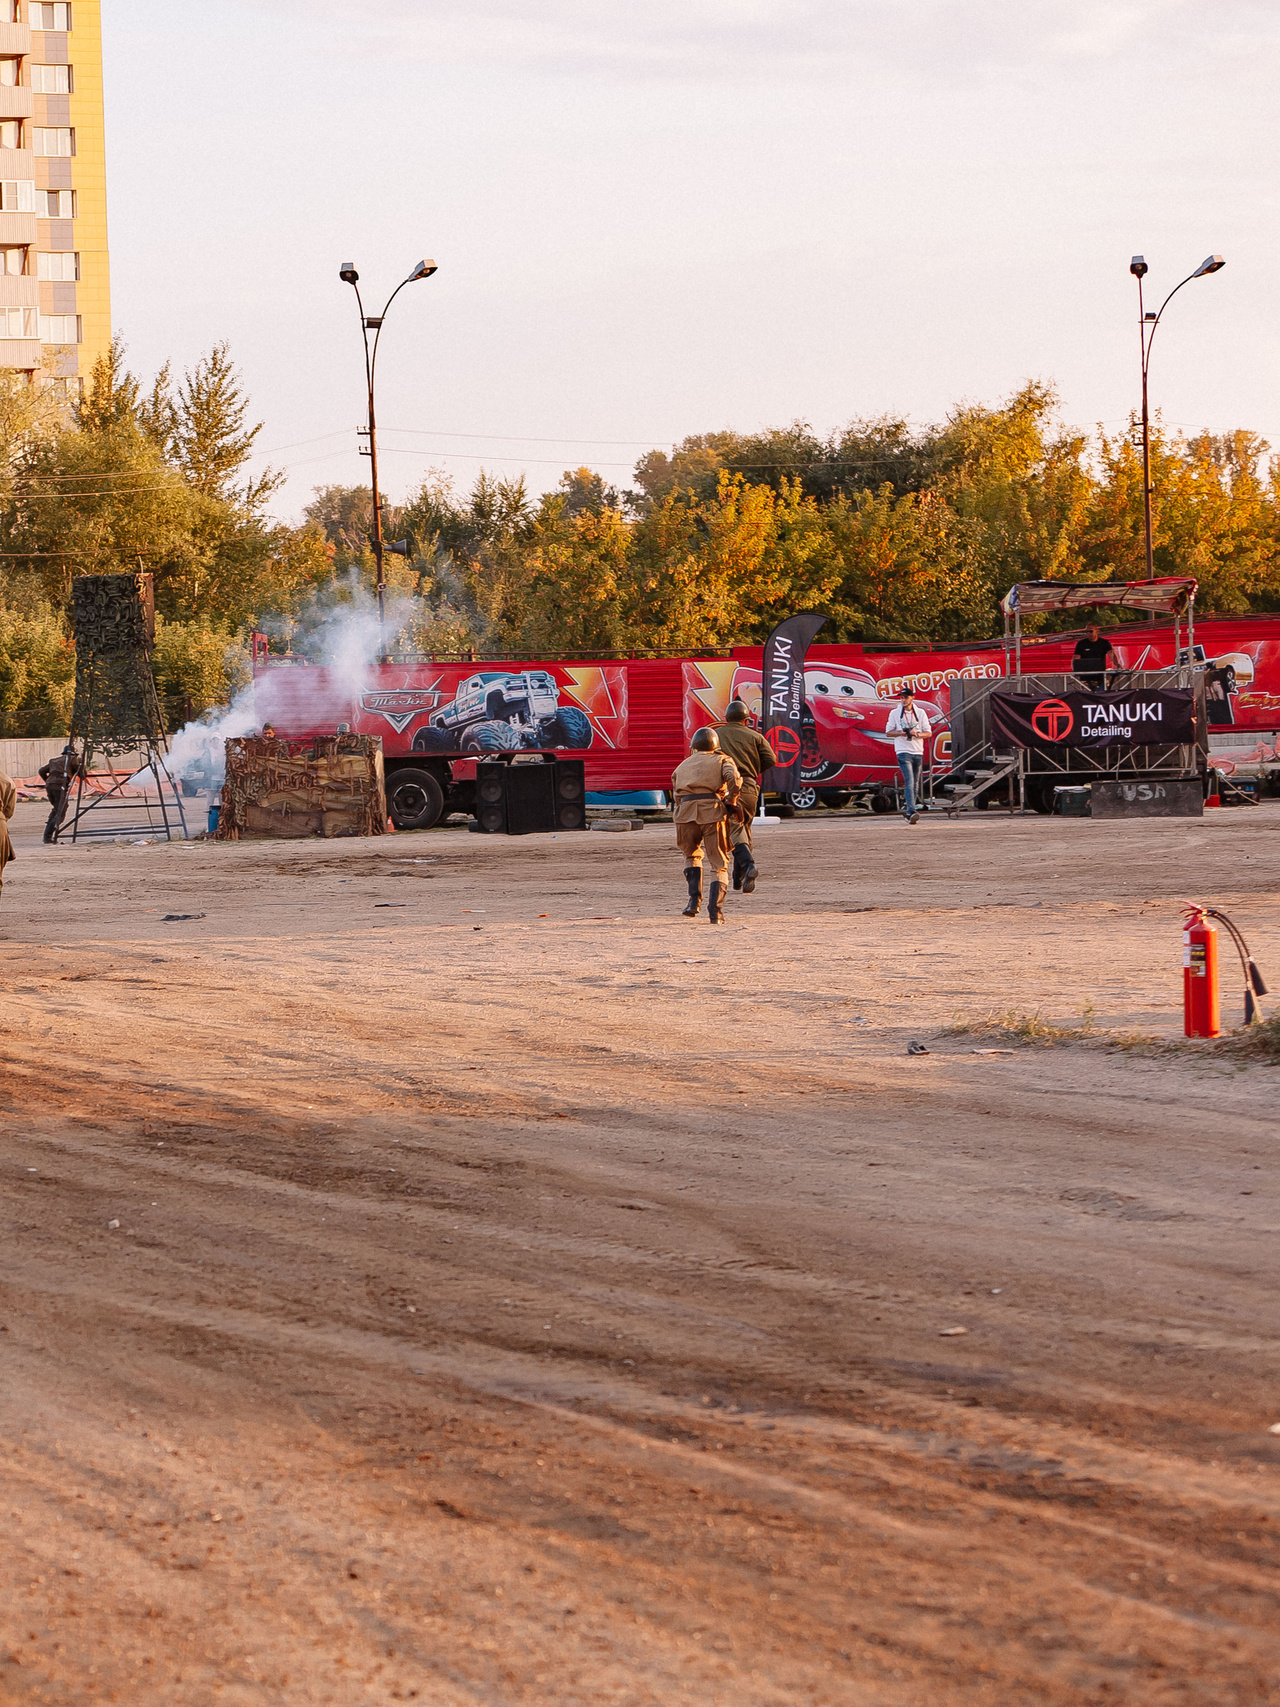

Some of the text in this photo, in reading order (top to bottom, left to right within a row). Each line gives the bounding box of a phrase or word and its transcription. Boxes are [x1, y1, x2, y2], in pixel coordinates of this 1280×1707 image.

[769, 635, 793, 716] TANUKI
[789, 670, 804, 720] Detailing
[1081, 702, 1163, 723] TANUKI
[1081, 725, 1132, 738] Detailing
[1122, 784, 1166, 802] USA
